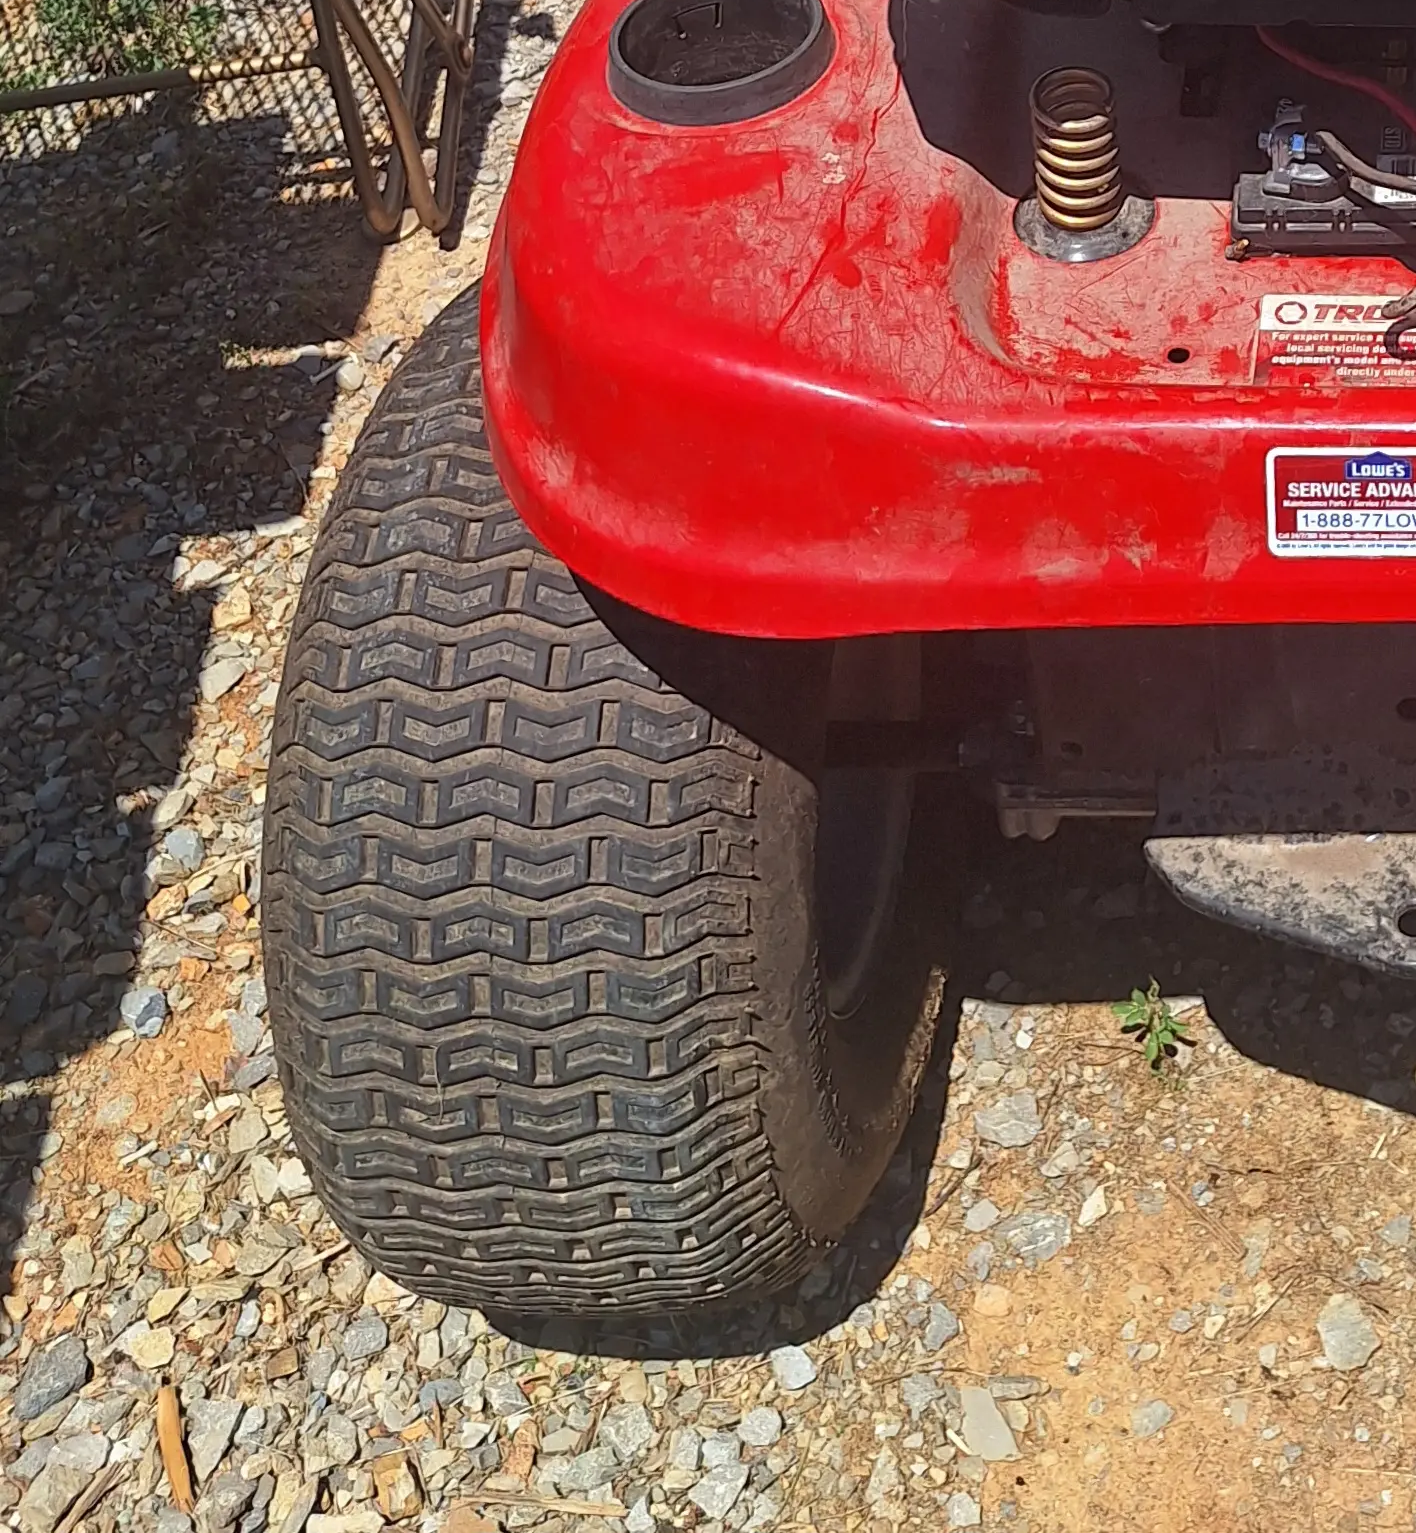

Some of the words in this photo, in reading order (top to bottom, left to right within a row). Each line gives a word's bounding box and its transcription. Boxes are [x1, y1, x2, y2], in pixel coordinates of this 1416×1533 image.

[1272, 332, 1289, 341] For
[1293, 332, 1329, 342] expert
[1332, 333, 1373, 342] service
[1286, 343, 1314, 352] local
[1317, 344, 1369, 354] servicing
[1271, 355, 1341, 365] equipment's
[1343, 356, 1378, 365] model
[1336, 367, 1380, 377] directly
[1383, 368, 1416, 376] under
[1288, 482, 1362, 498] SERVICE
[1282, 499, 1328, 507] Maintenance
[1329, 499, 1347, 507] Parts
